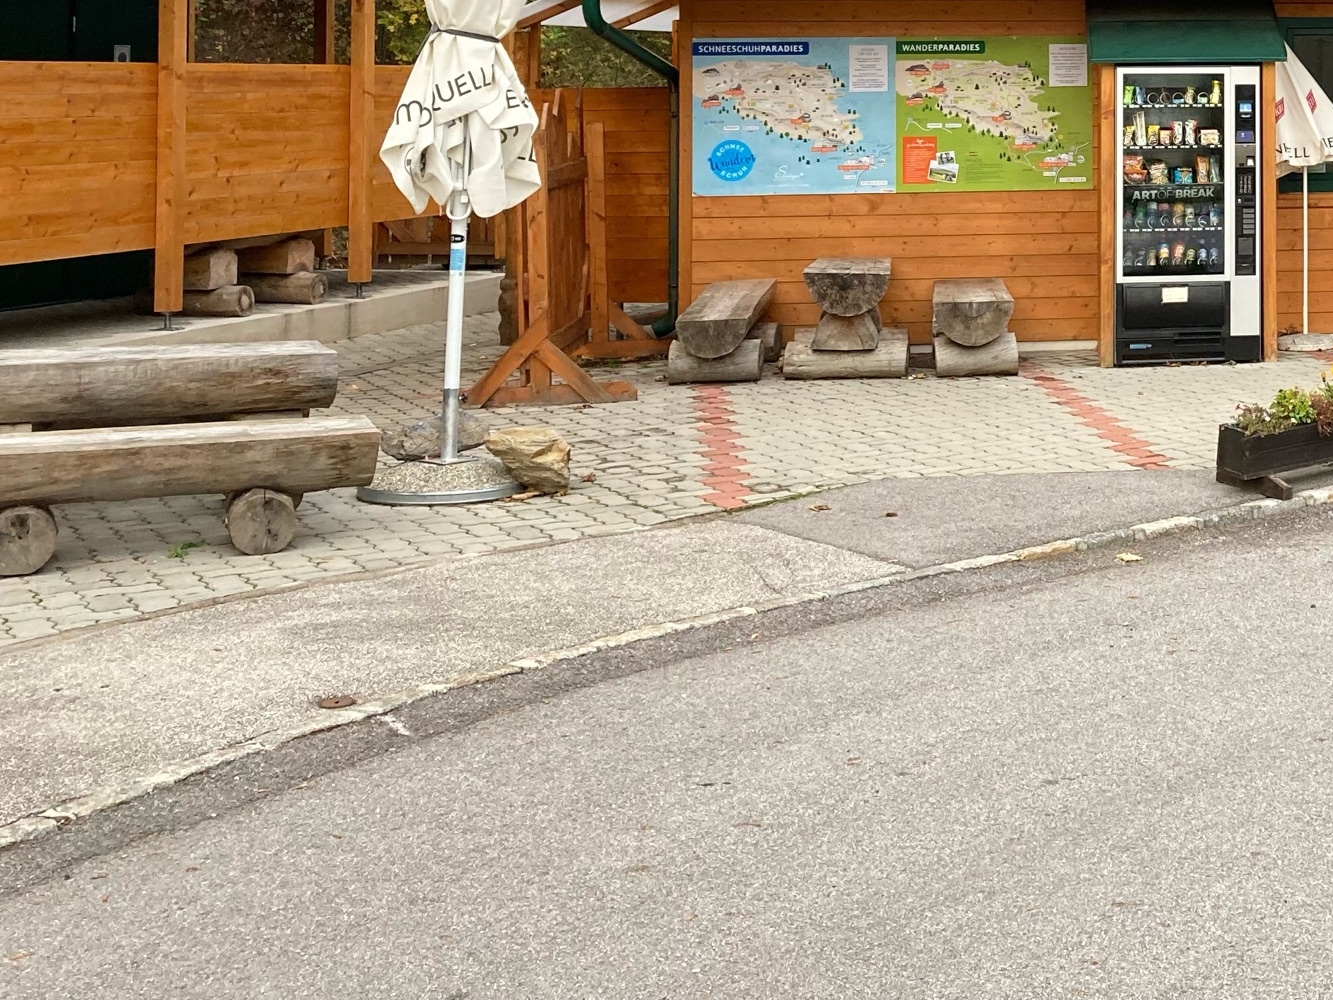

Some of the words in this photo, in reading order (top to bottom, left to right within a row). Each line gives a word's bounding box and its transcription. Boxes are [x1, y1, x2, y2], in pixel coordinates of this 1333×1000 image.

[698, 45, 804, 53] SCHNEESCHUHPARADIES
[902, 43, 980, 52] WANDERPARADIES
[1175, 188, 1215, 199] BREAK
